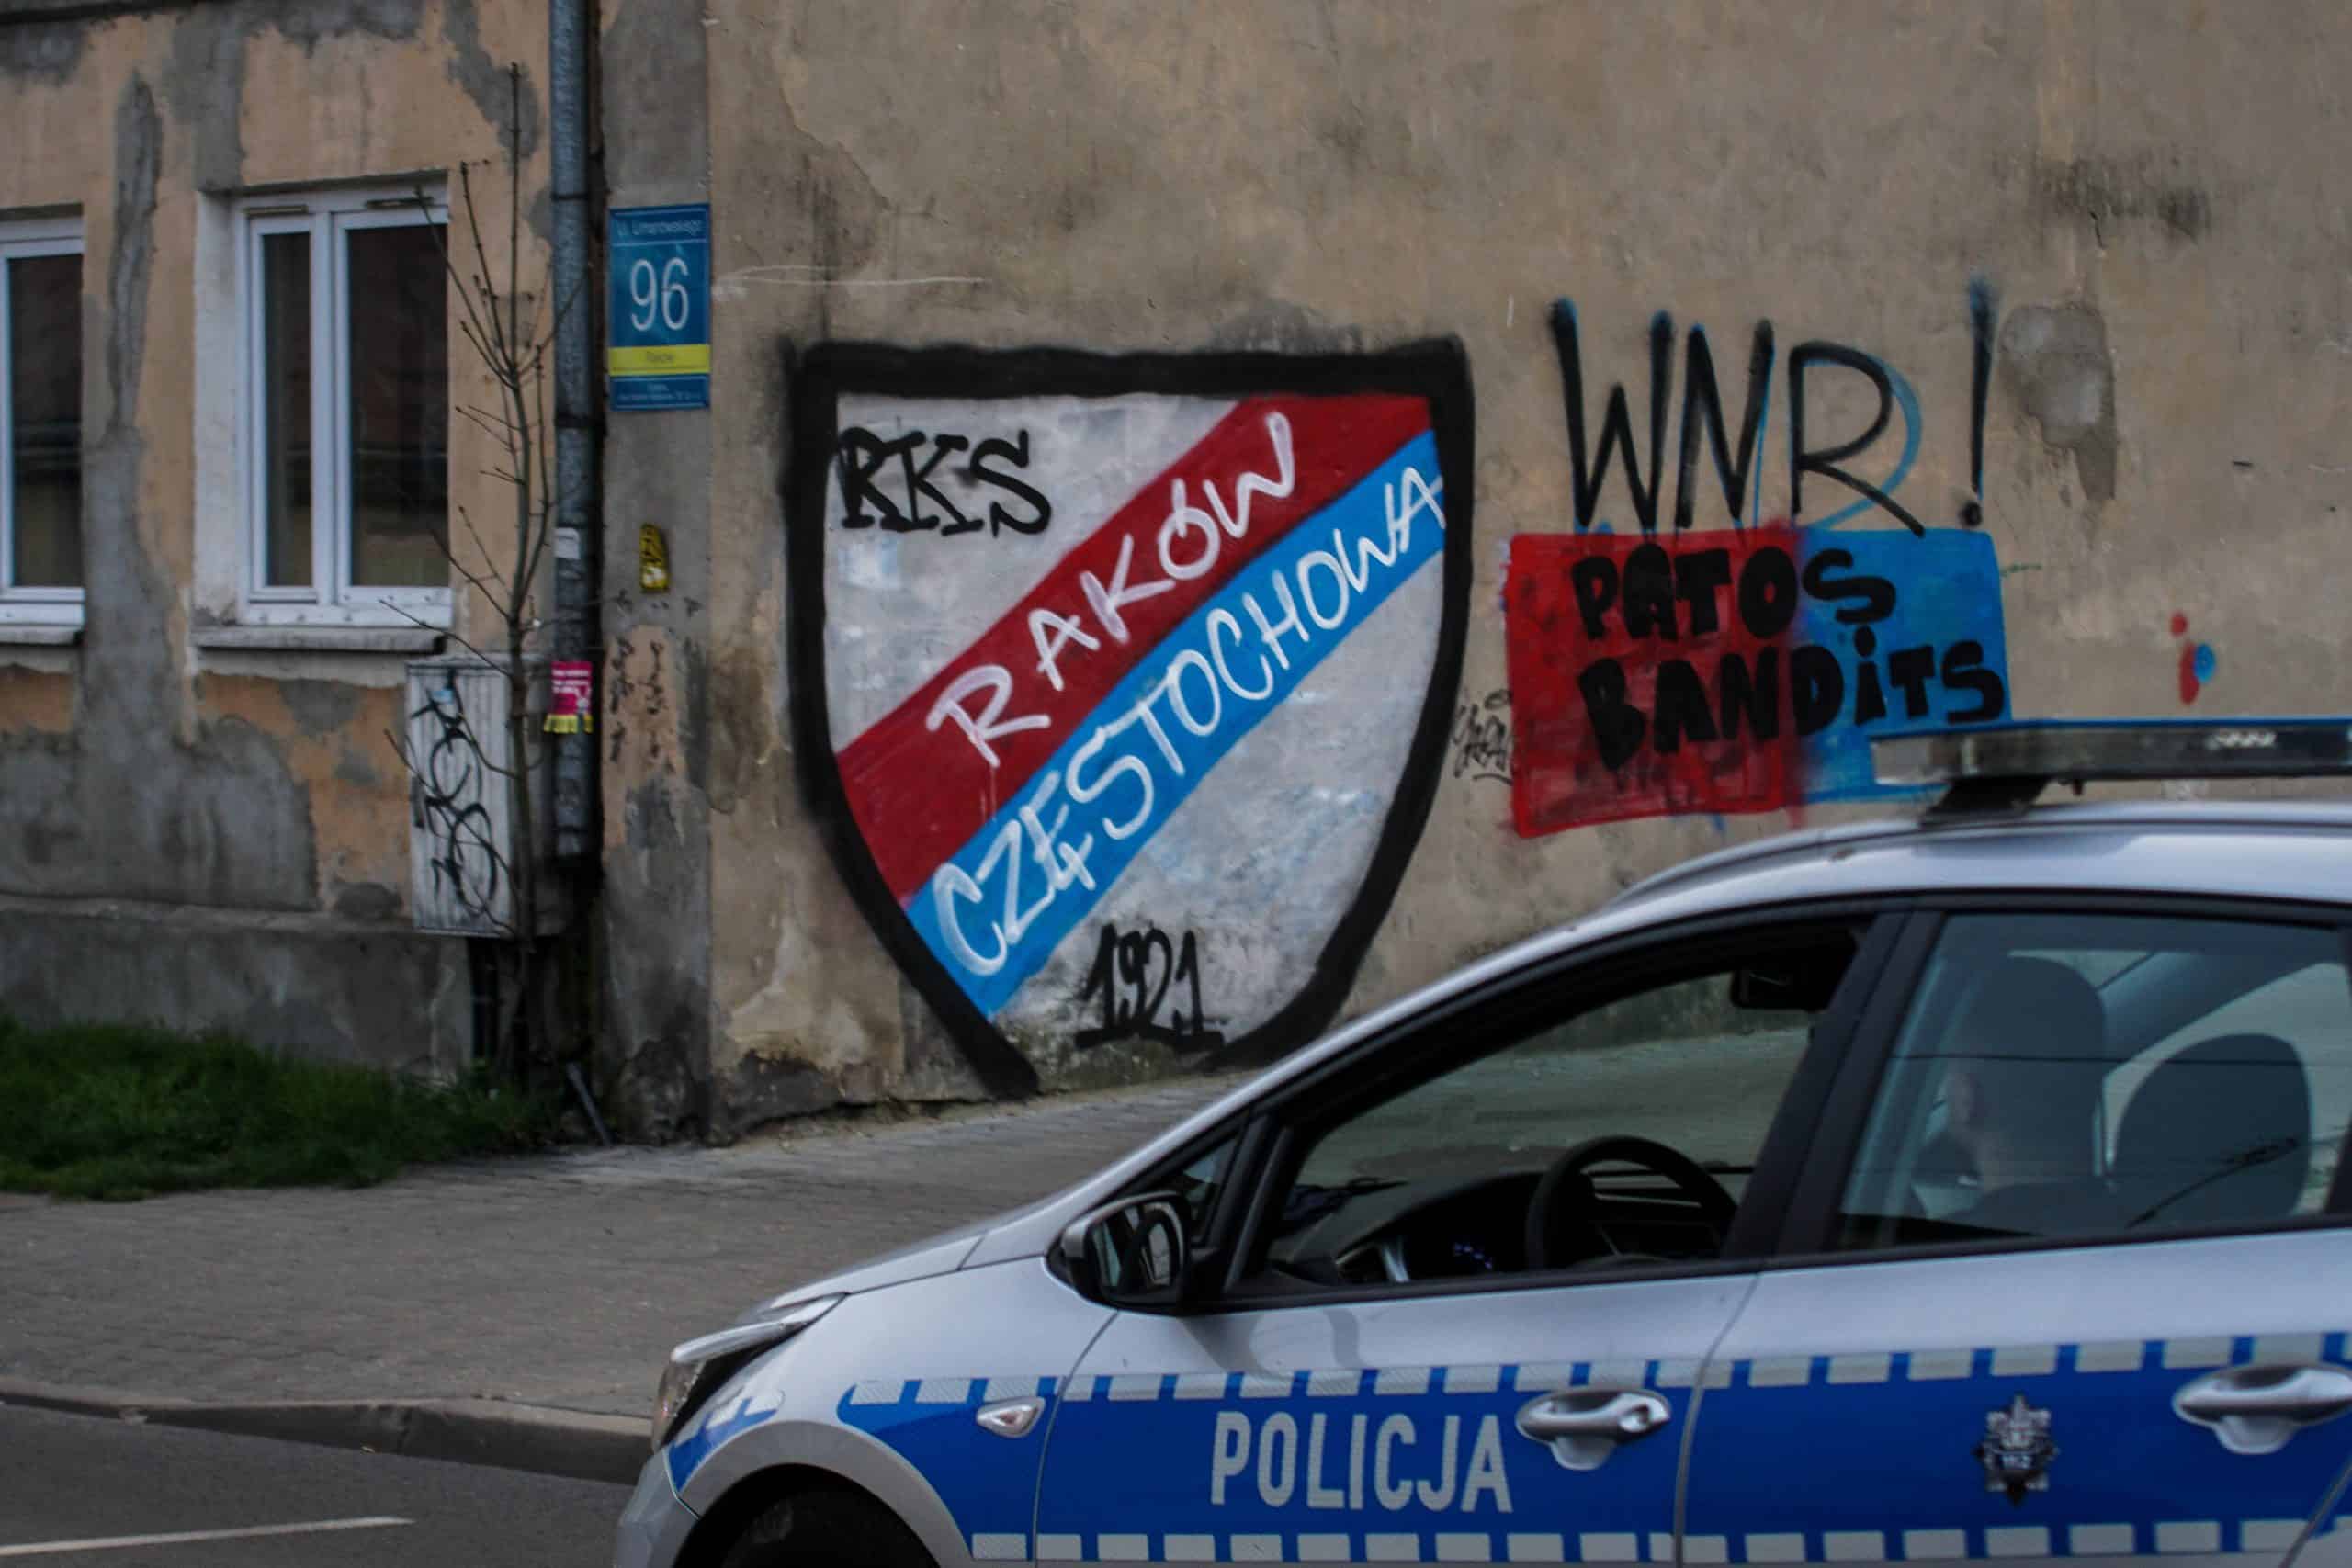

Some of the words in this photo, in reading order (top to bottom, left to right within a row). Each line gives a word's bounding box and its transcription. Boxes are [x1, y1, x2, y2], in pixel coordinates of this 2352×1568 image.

[630, 256, 690, 332] 96
[834, 427, 1051, 537] RKS
[926, 411, 1295, 768] RAKÓW
[1572, 542, 1896, 642] PATOS
[1075, 923, 1226, 1053] 1921
[1210, 1410, 1513, 1513] POLICJA
